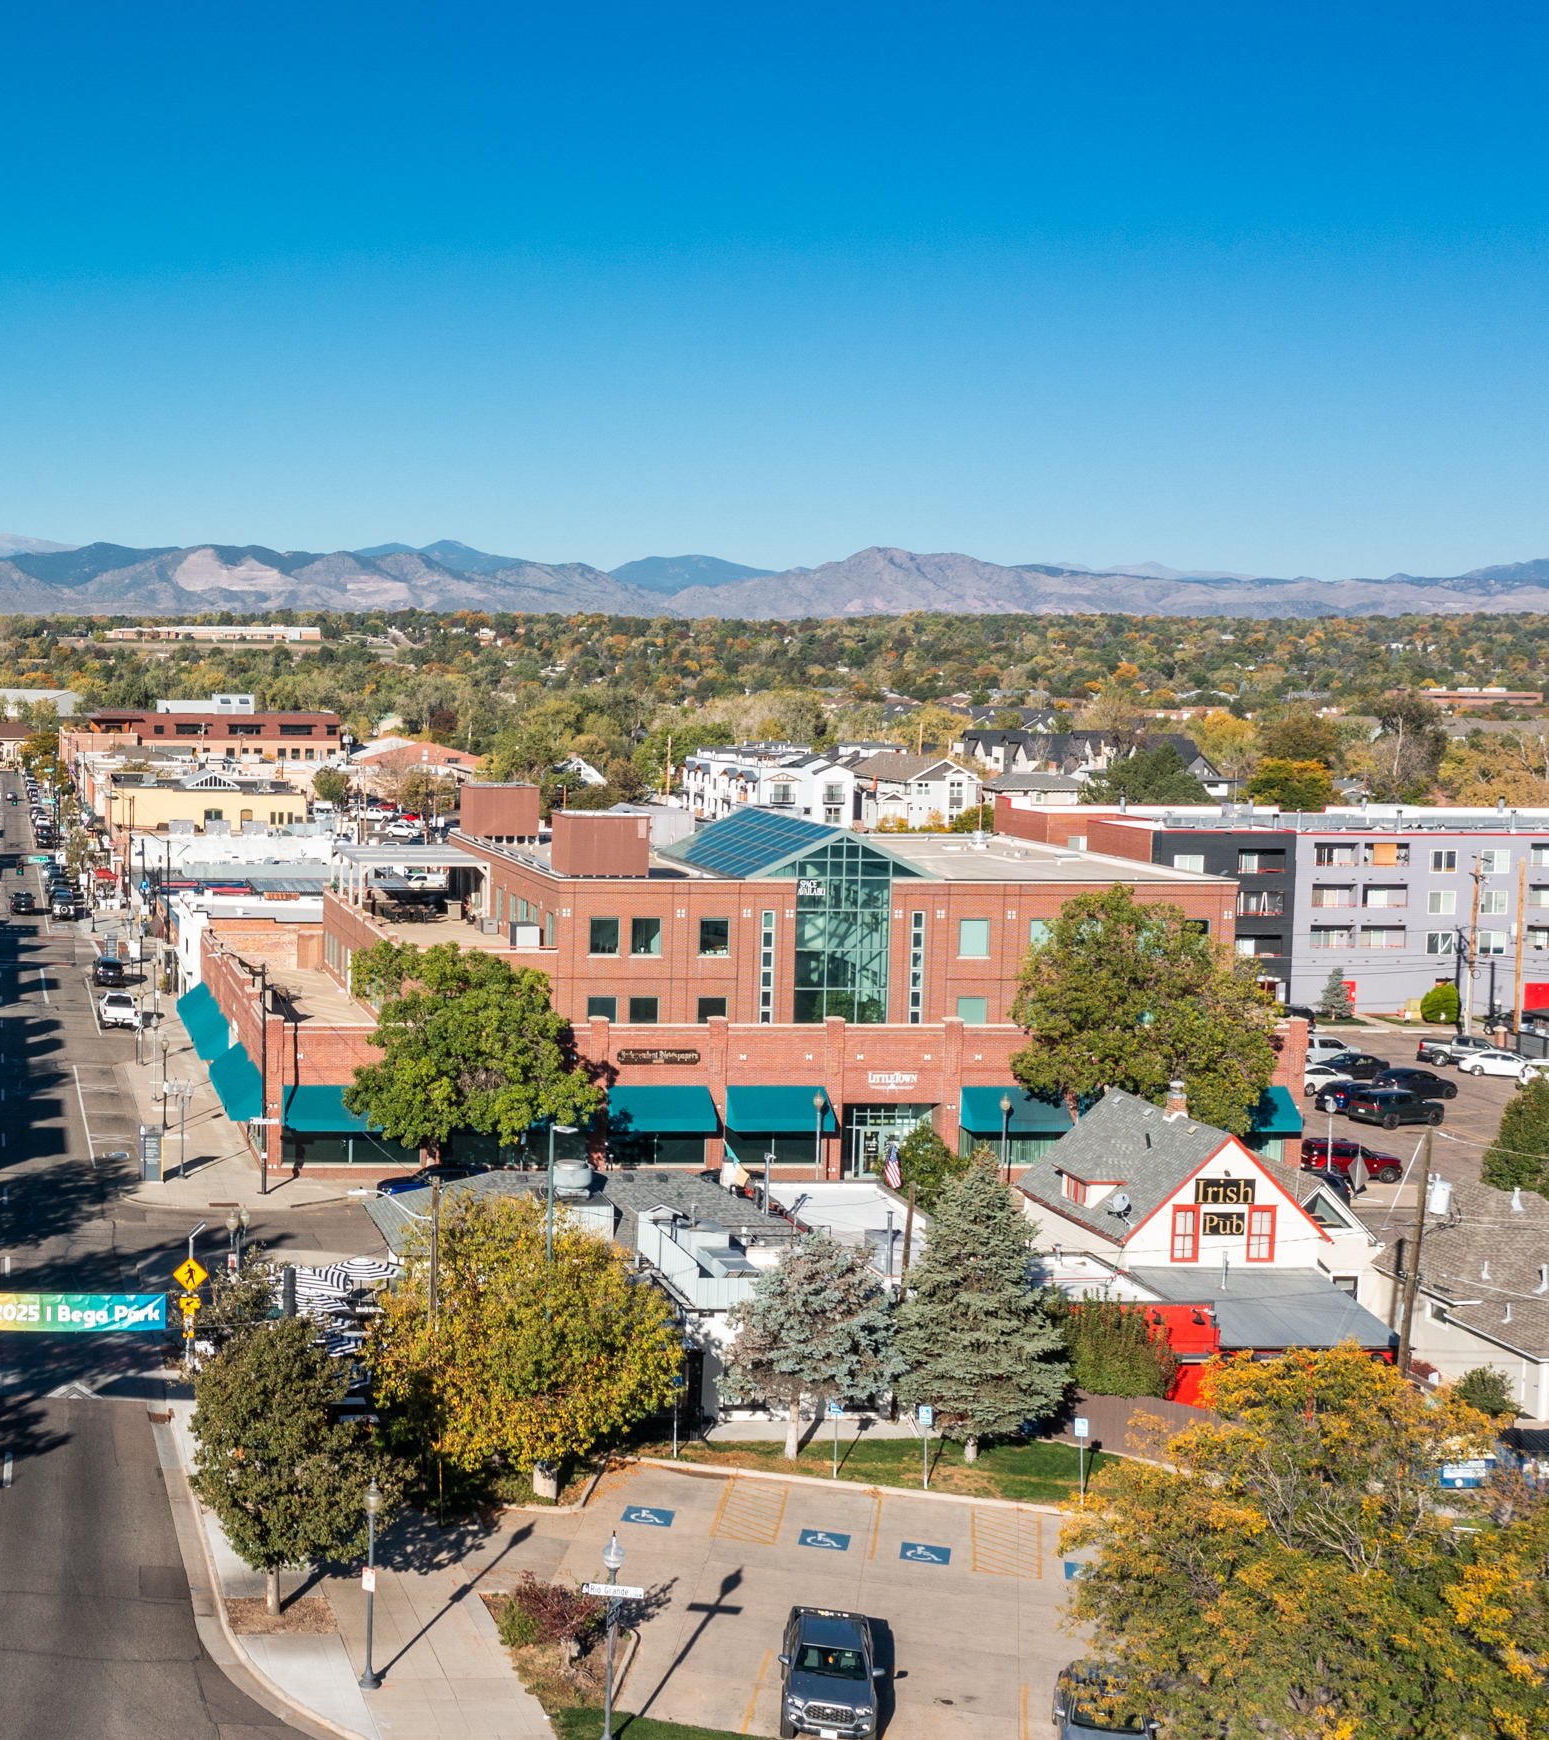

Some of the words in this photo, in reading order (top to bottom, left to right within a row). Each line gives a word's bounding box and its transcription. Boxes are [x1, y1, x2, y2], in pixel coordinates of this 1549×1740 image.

[800, 880, 817, 888] SPACE
[1195, 1179, 1254, 1204] Irish
[1203, 1214, 1244, 1235] Pub
[57, 1305, 108, 1329] Bega
[114, 1305, 160, 1322] Park
[590, 1584, 602, 1594] Rio
[603, 1586, 629, 1596] Grande
